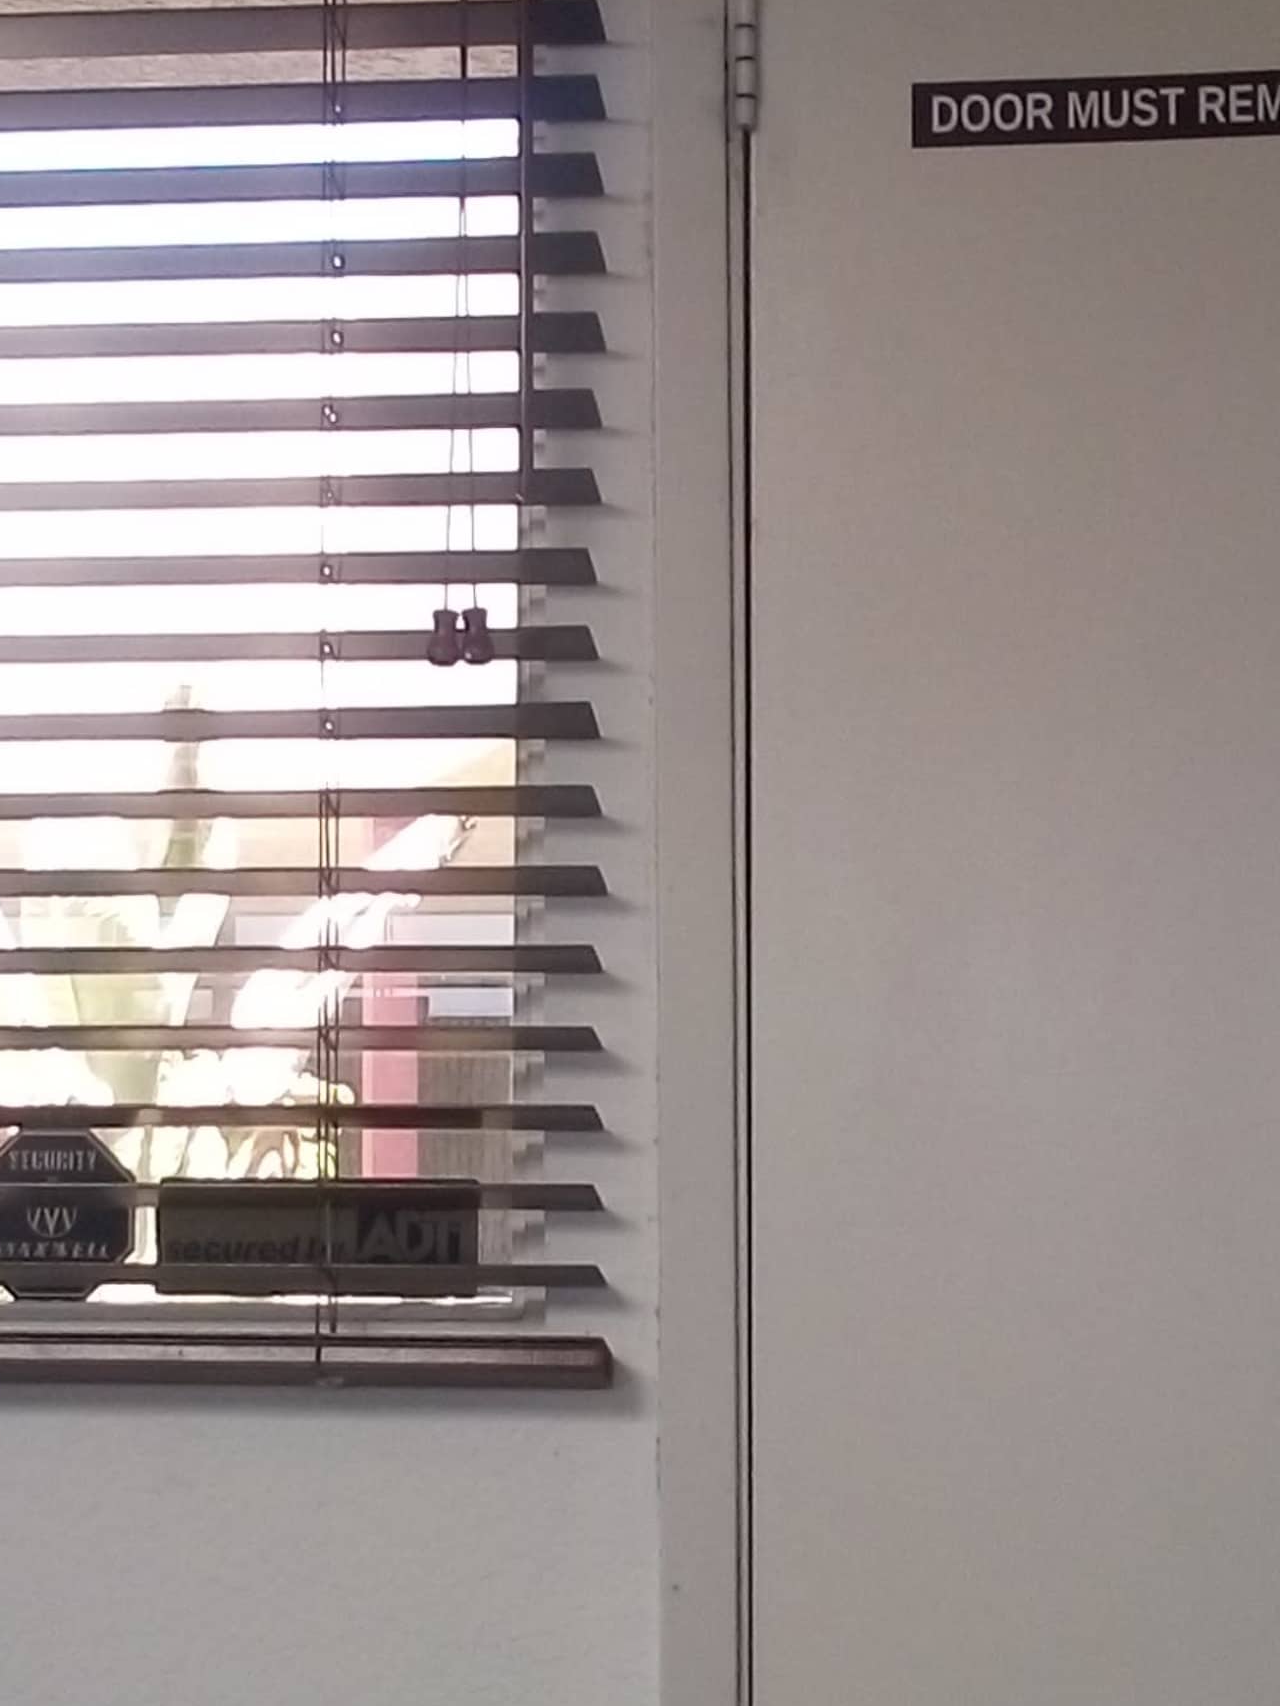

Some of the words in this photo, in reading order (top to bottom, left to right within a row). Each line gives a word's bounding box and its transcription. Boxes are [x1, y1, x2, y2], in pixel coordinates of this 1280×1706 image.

[931, 92, 1054, 134] DOOR
[1067, 86, 1186, 130] MUST
[8, 1148, 98, 1172] SECURITY
